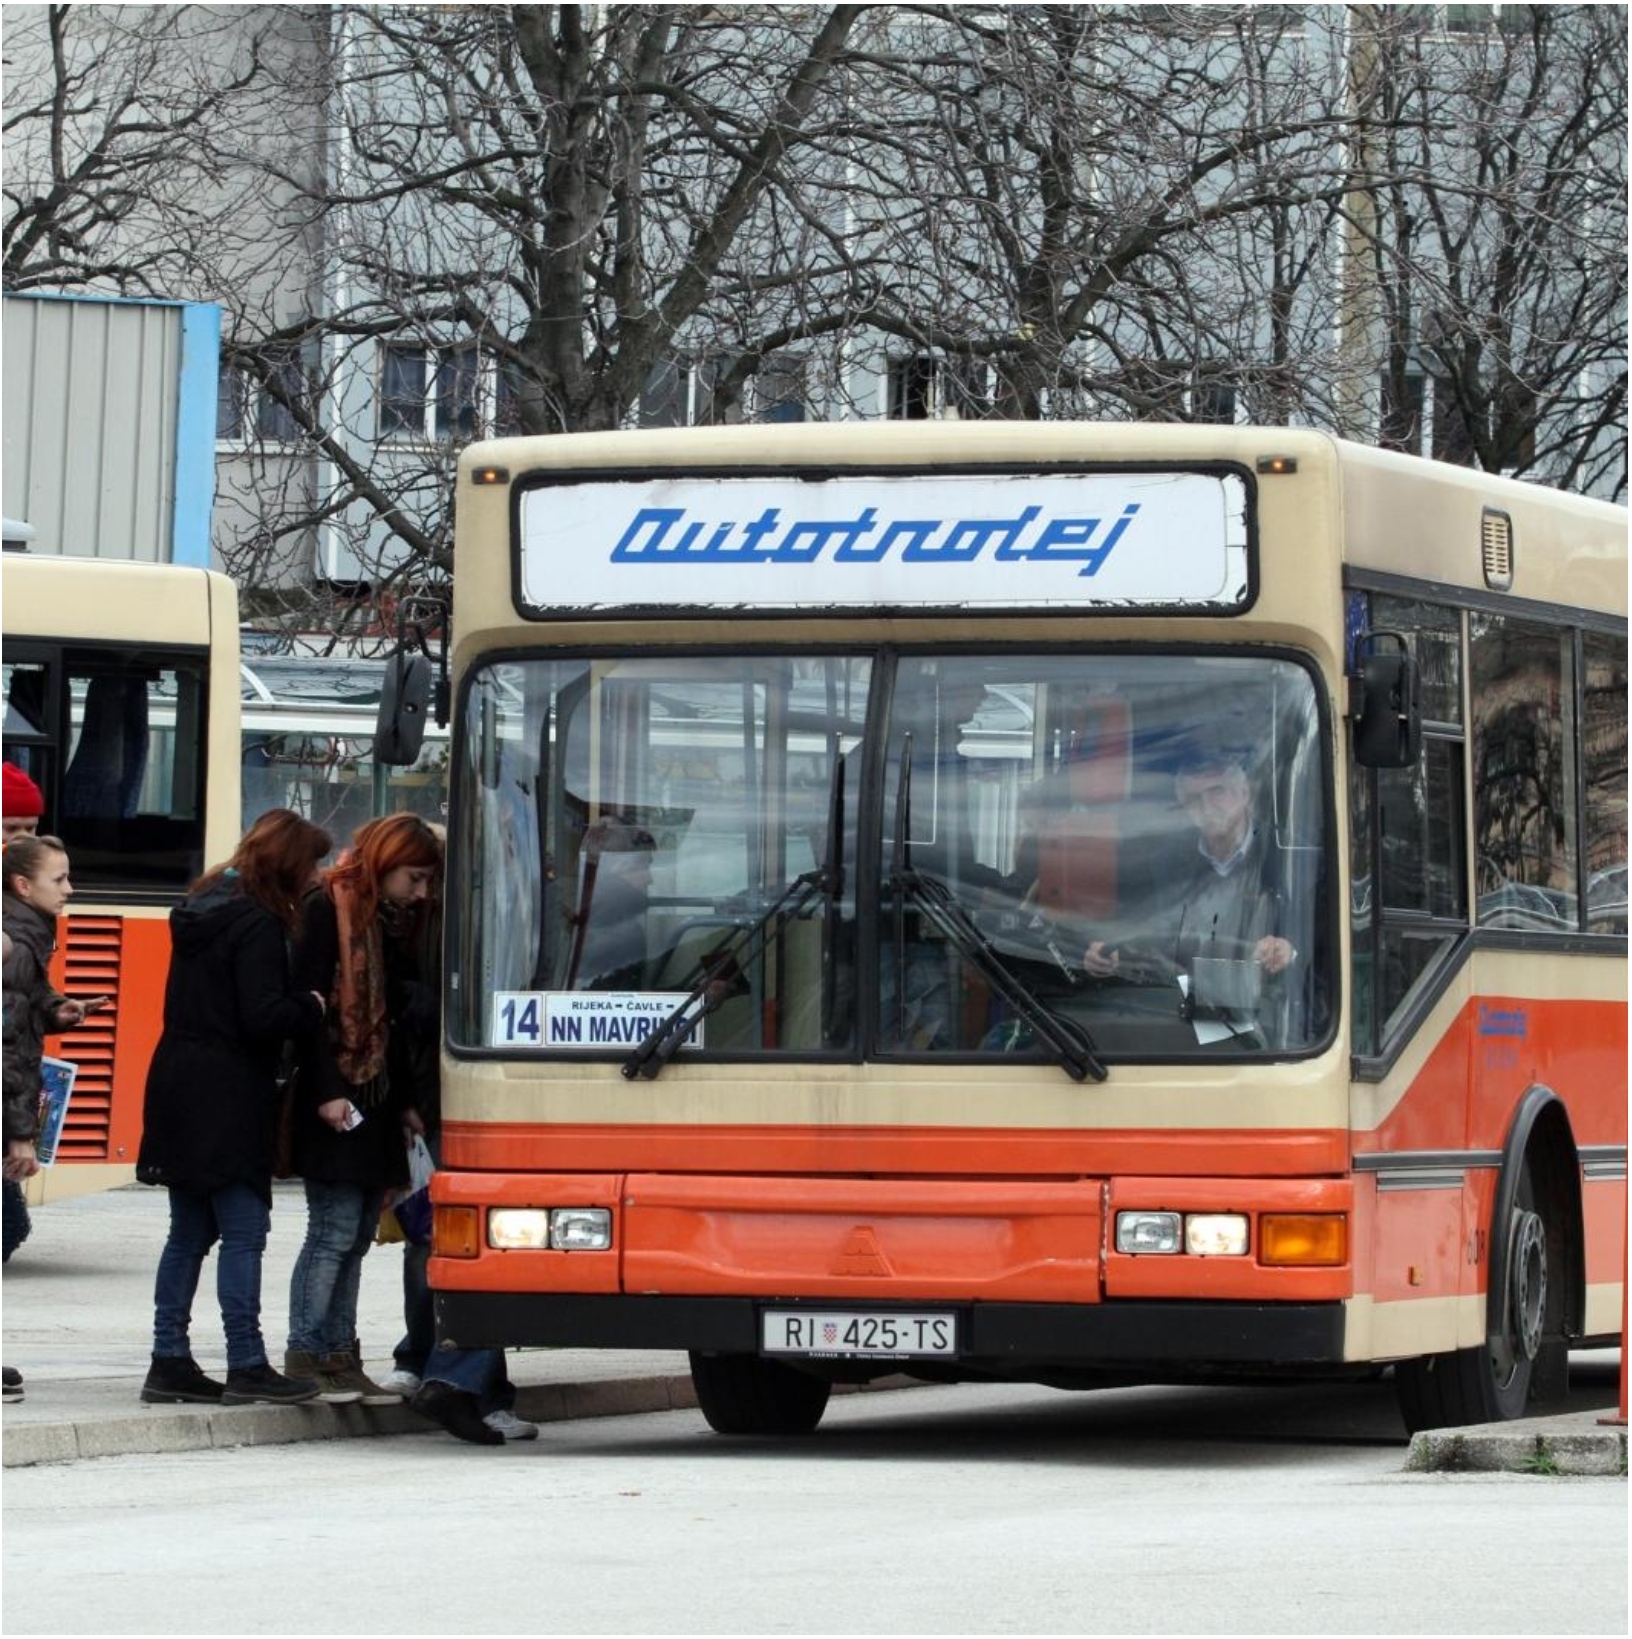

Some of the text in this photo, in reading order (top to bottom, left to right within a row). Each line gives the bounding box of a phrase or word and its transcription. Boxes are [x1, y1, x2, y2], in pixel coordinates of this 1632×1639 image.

[610, 503, 1142, 577] Autotrolej
[501, 998, 540, 1041] 14
[571, 1001, 613, 1010] RIJEKA
[551, 1016, 582, 1042] NN
[786, 1318, 949, 1350] RI 425-TS
